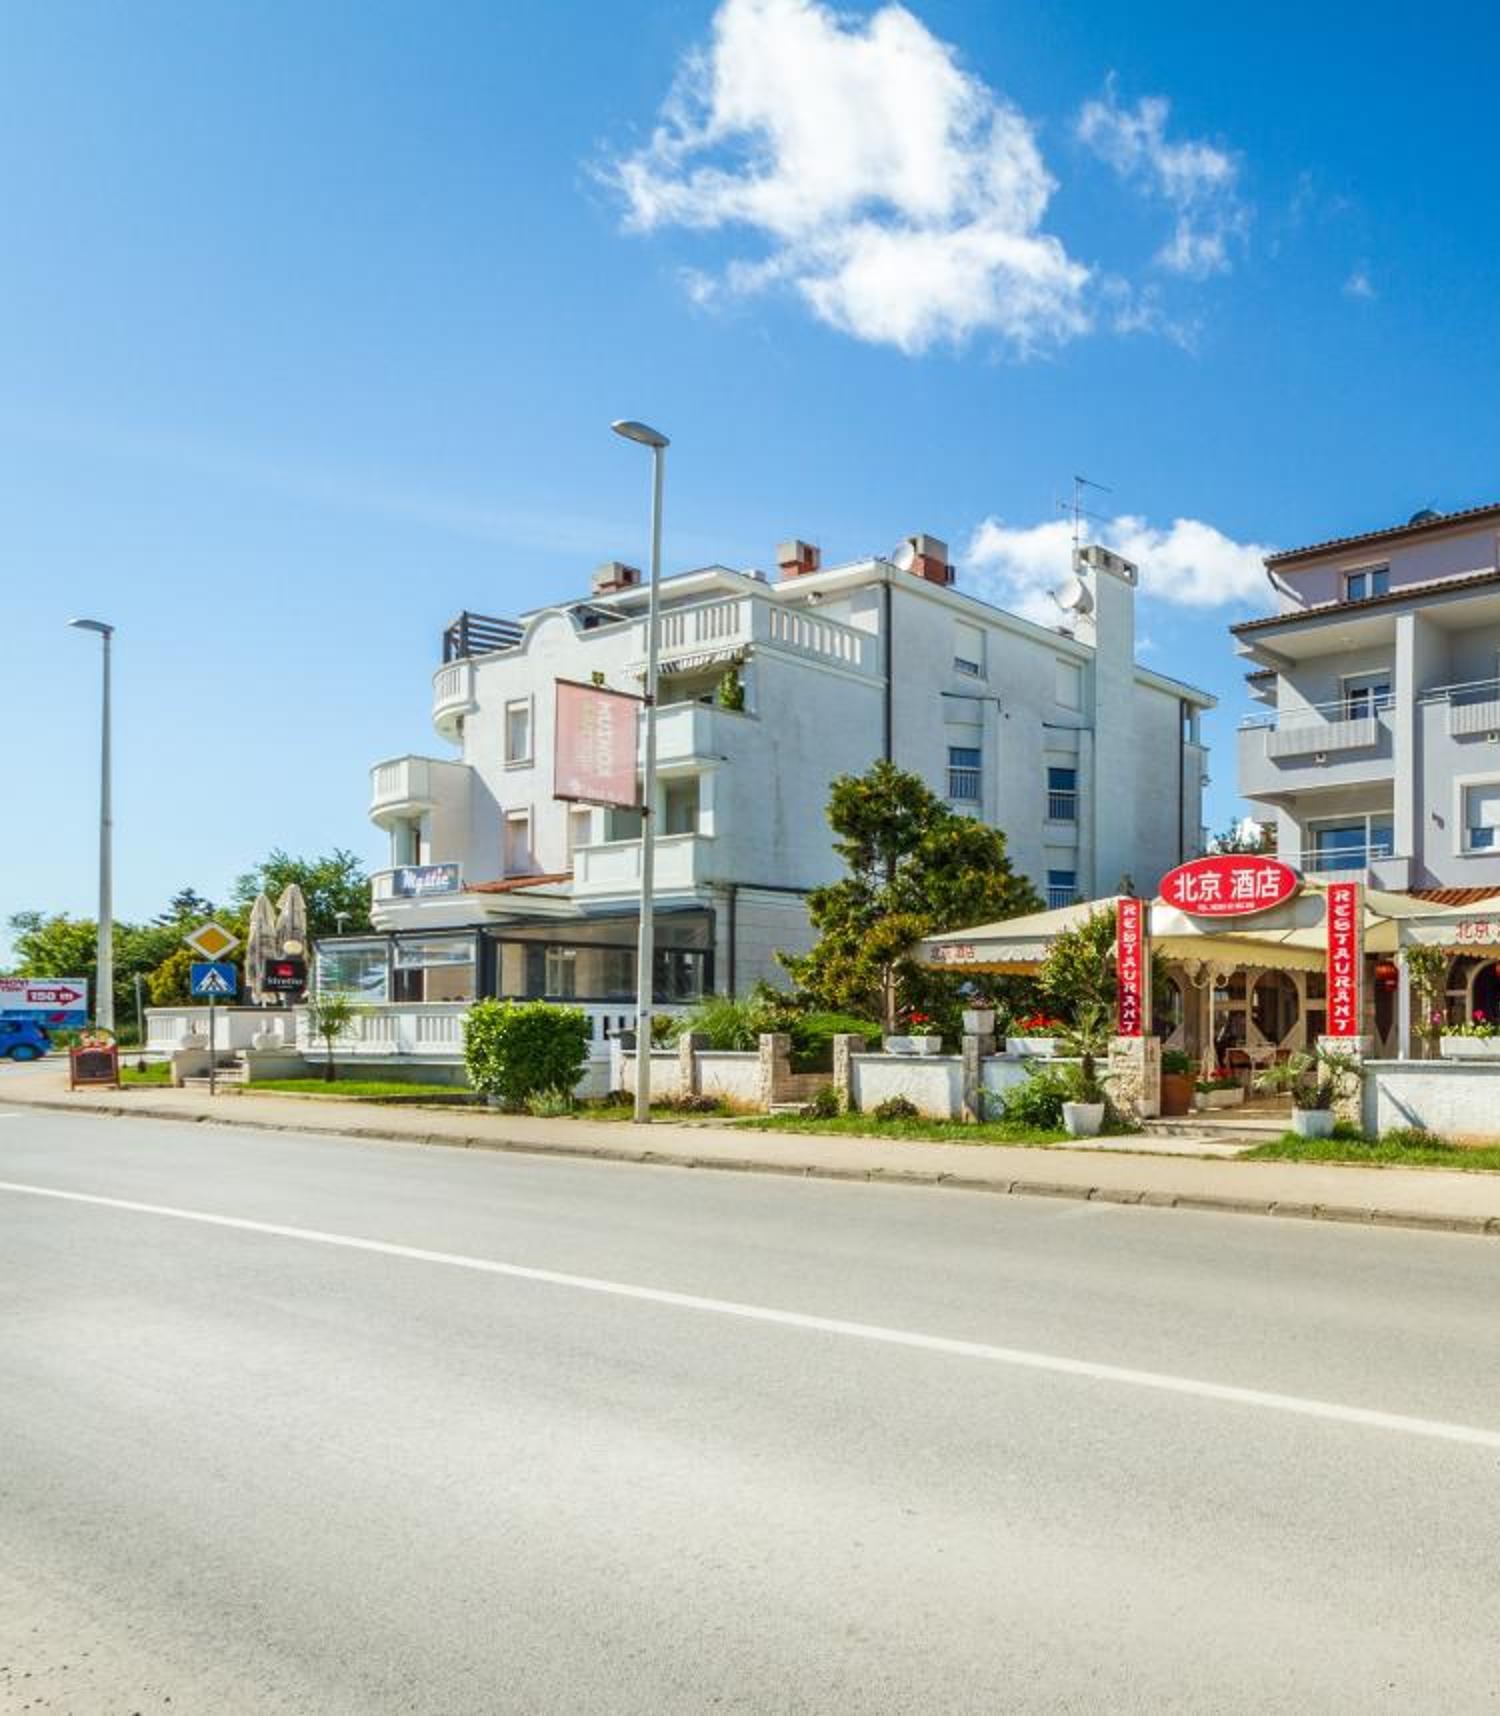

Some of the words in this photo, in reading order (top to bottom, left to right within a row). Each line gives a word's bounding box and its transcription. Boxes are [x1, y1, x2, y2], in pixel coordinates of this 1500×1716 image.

[1173, 870, 1222, 902] 北京
[1230, 866, 1281, 899] 酒店
[31, 991, 57, 1001] 150
[1122, 904, 1138, 1031] RESTAURANT
[1332, 889, 1351, 1031] RESTAURANT
